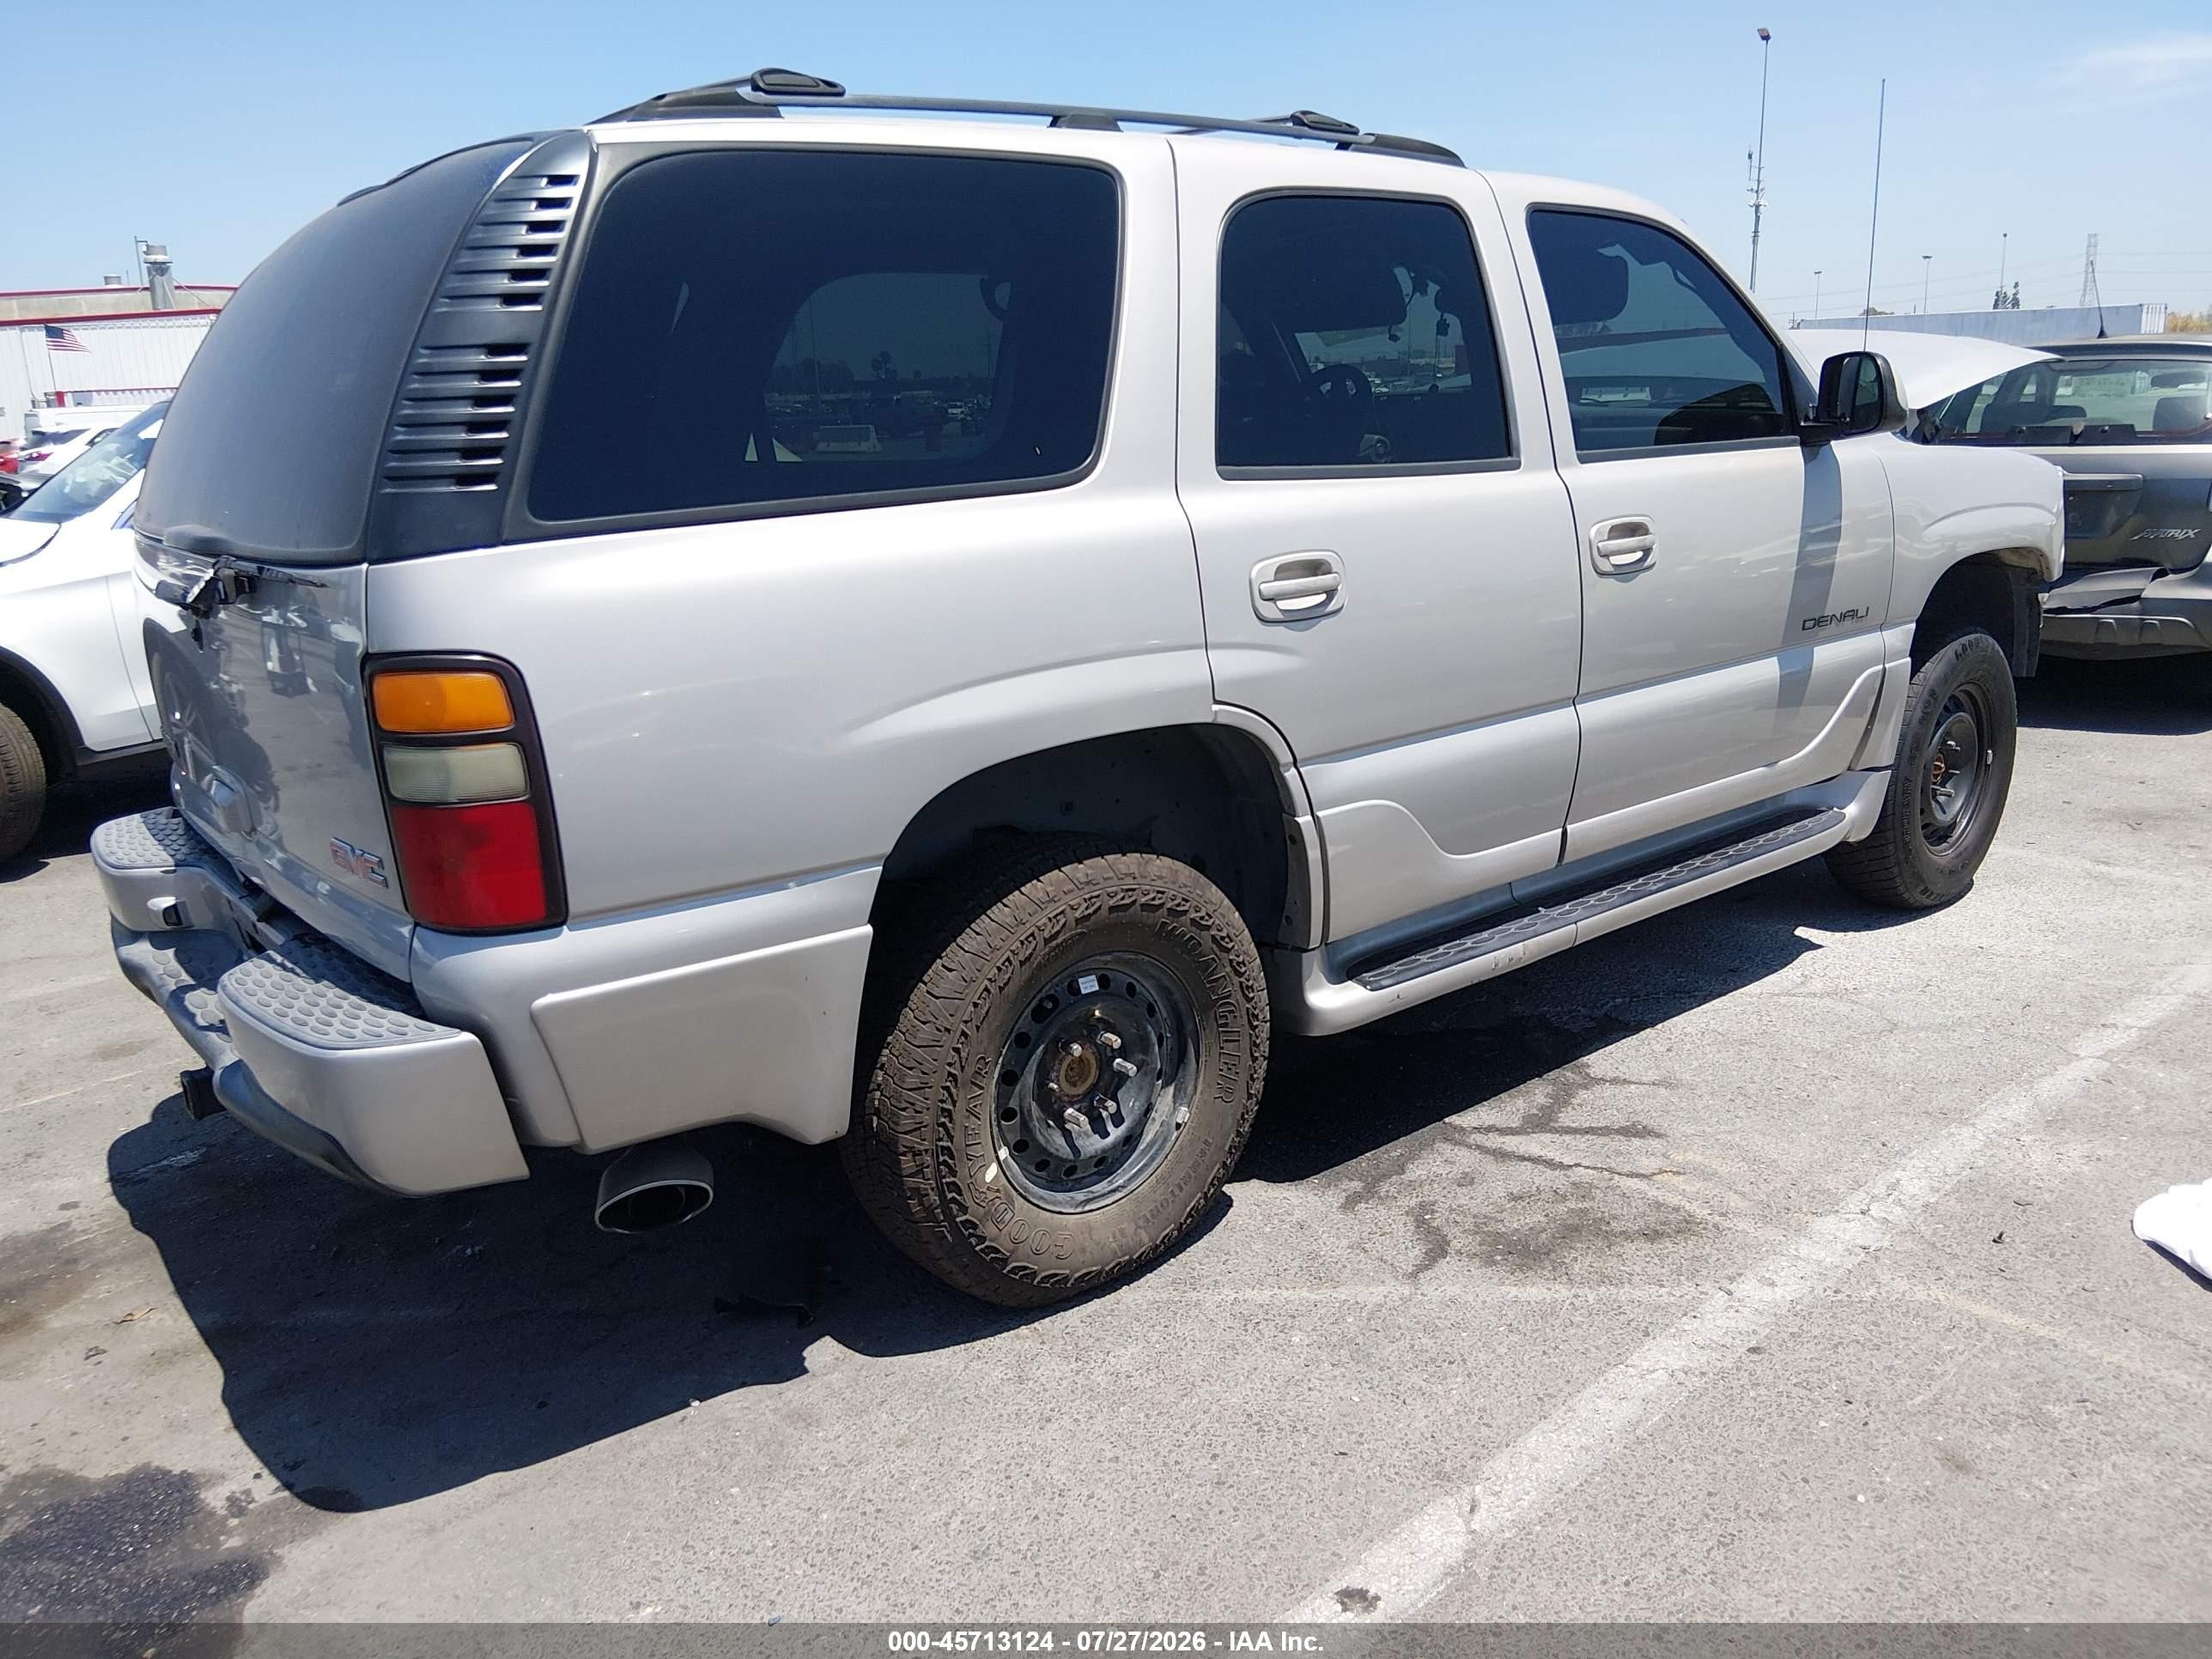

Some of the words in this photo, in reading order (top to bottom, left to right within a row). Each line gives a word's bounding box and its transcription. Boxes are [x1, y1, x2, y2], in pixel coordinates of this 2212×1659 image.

[1801, 606, 1869, 631] DENALI
[330, 836, 389, 889] GMC
[965, 1053, 1075, 1261] GOODYEAR
